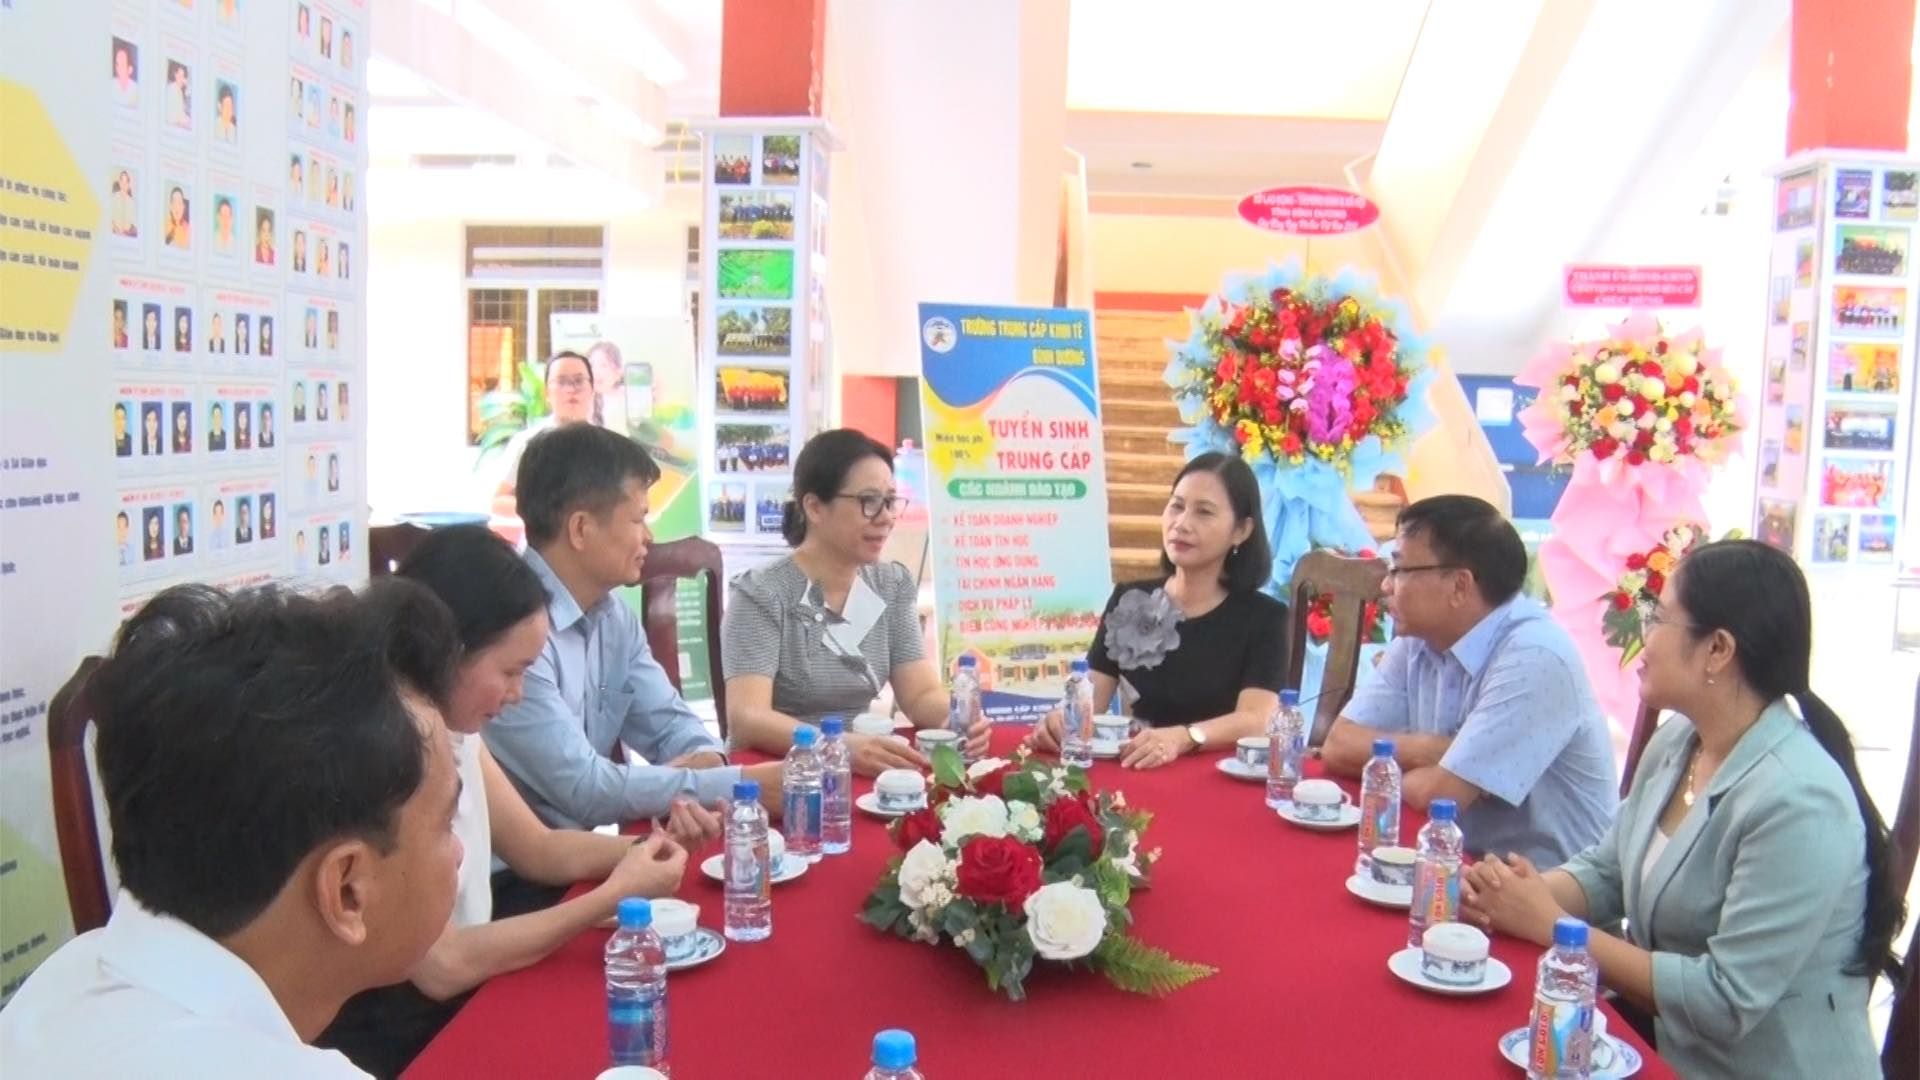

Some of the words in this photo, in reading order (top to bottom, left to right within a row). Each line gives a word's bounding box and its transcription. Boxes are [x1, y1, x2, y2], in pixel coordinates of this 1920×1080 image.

[988, 410, 1043, 438] TUYỂN
[1049, 420, 1089, 438] SINH
[996, 451, 1054, 469] TRUNG
[1059, 443, 1091, 469] CẤP
